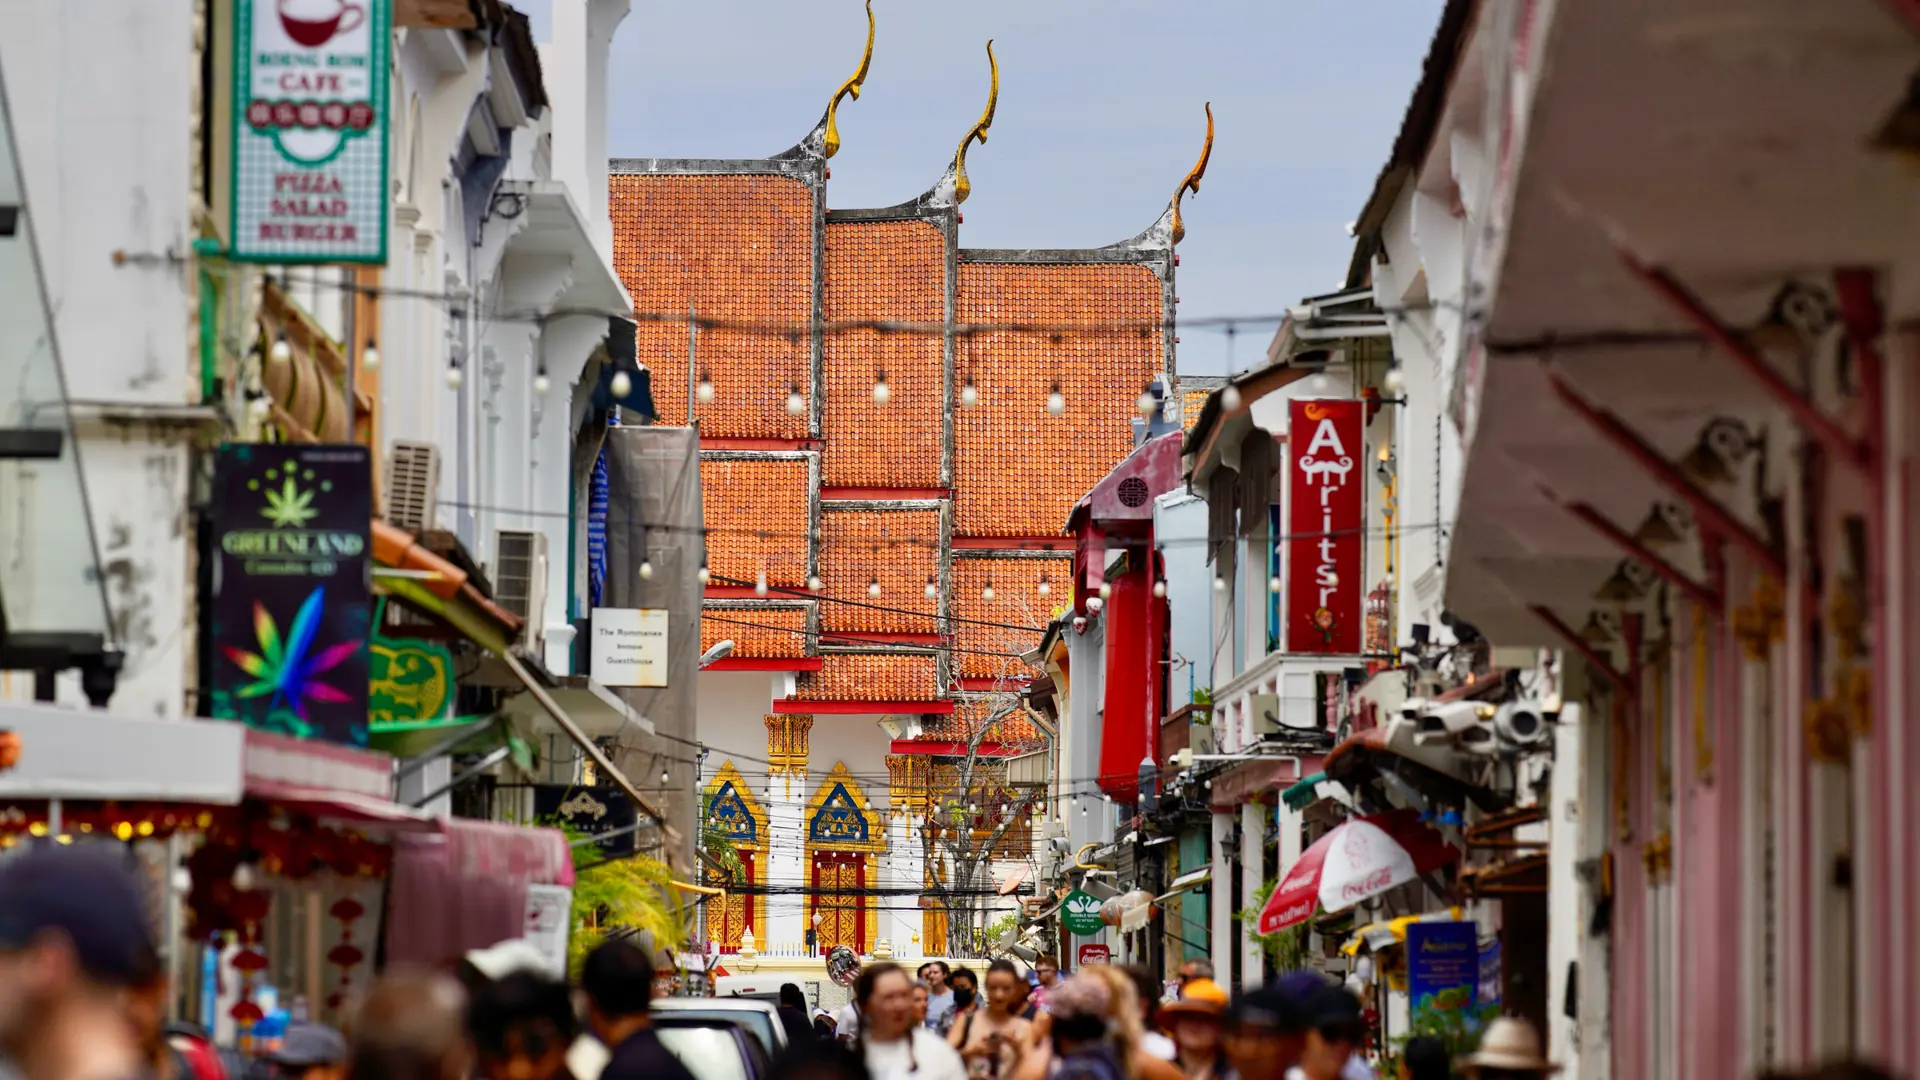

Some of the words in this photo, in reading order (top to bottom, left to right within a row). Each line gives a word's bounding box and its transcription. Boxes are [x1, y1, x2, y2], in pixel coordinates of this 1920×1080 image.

[279, 73, 341, 91] CAFE
[274, 173, 342, 193] PIZZA
[271, 198, 348, 217] SALAD
[259, 223, 356, 241] BURGER
[222, 531, 364, 556] GREENLAND
[599, 628, 614, 636] The
[606, 656, 653, 665] Guesthouse
